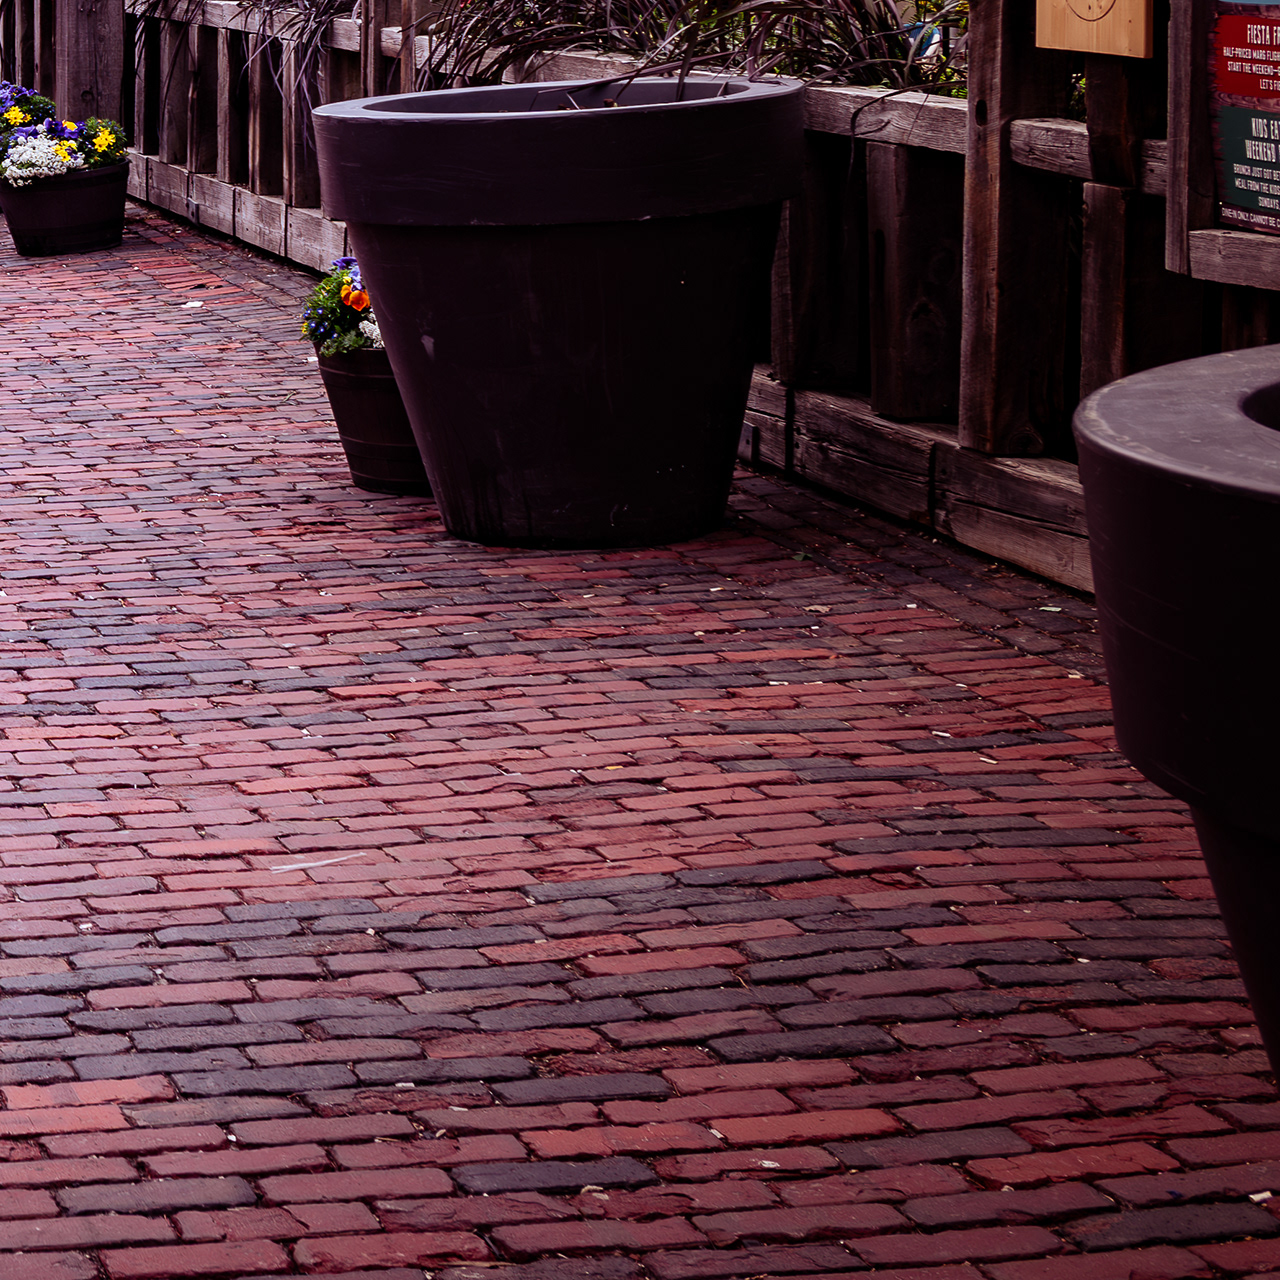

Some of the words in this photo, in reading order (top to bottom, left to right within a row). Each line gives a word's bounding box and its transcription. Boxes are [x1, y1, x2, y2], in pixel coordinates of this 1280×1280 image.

[1247, 24, 1271, 45] FIESTA
[1251, 117, 1269, 139] KIDS
[1244, 139, 1277, 163] WEEKEND
